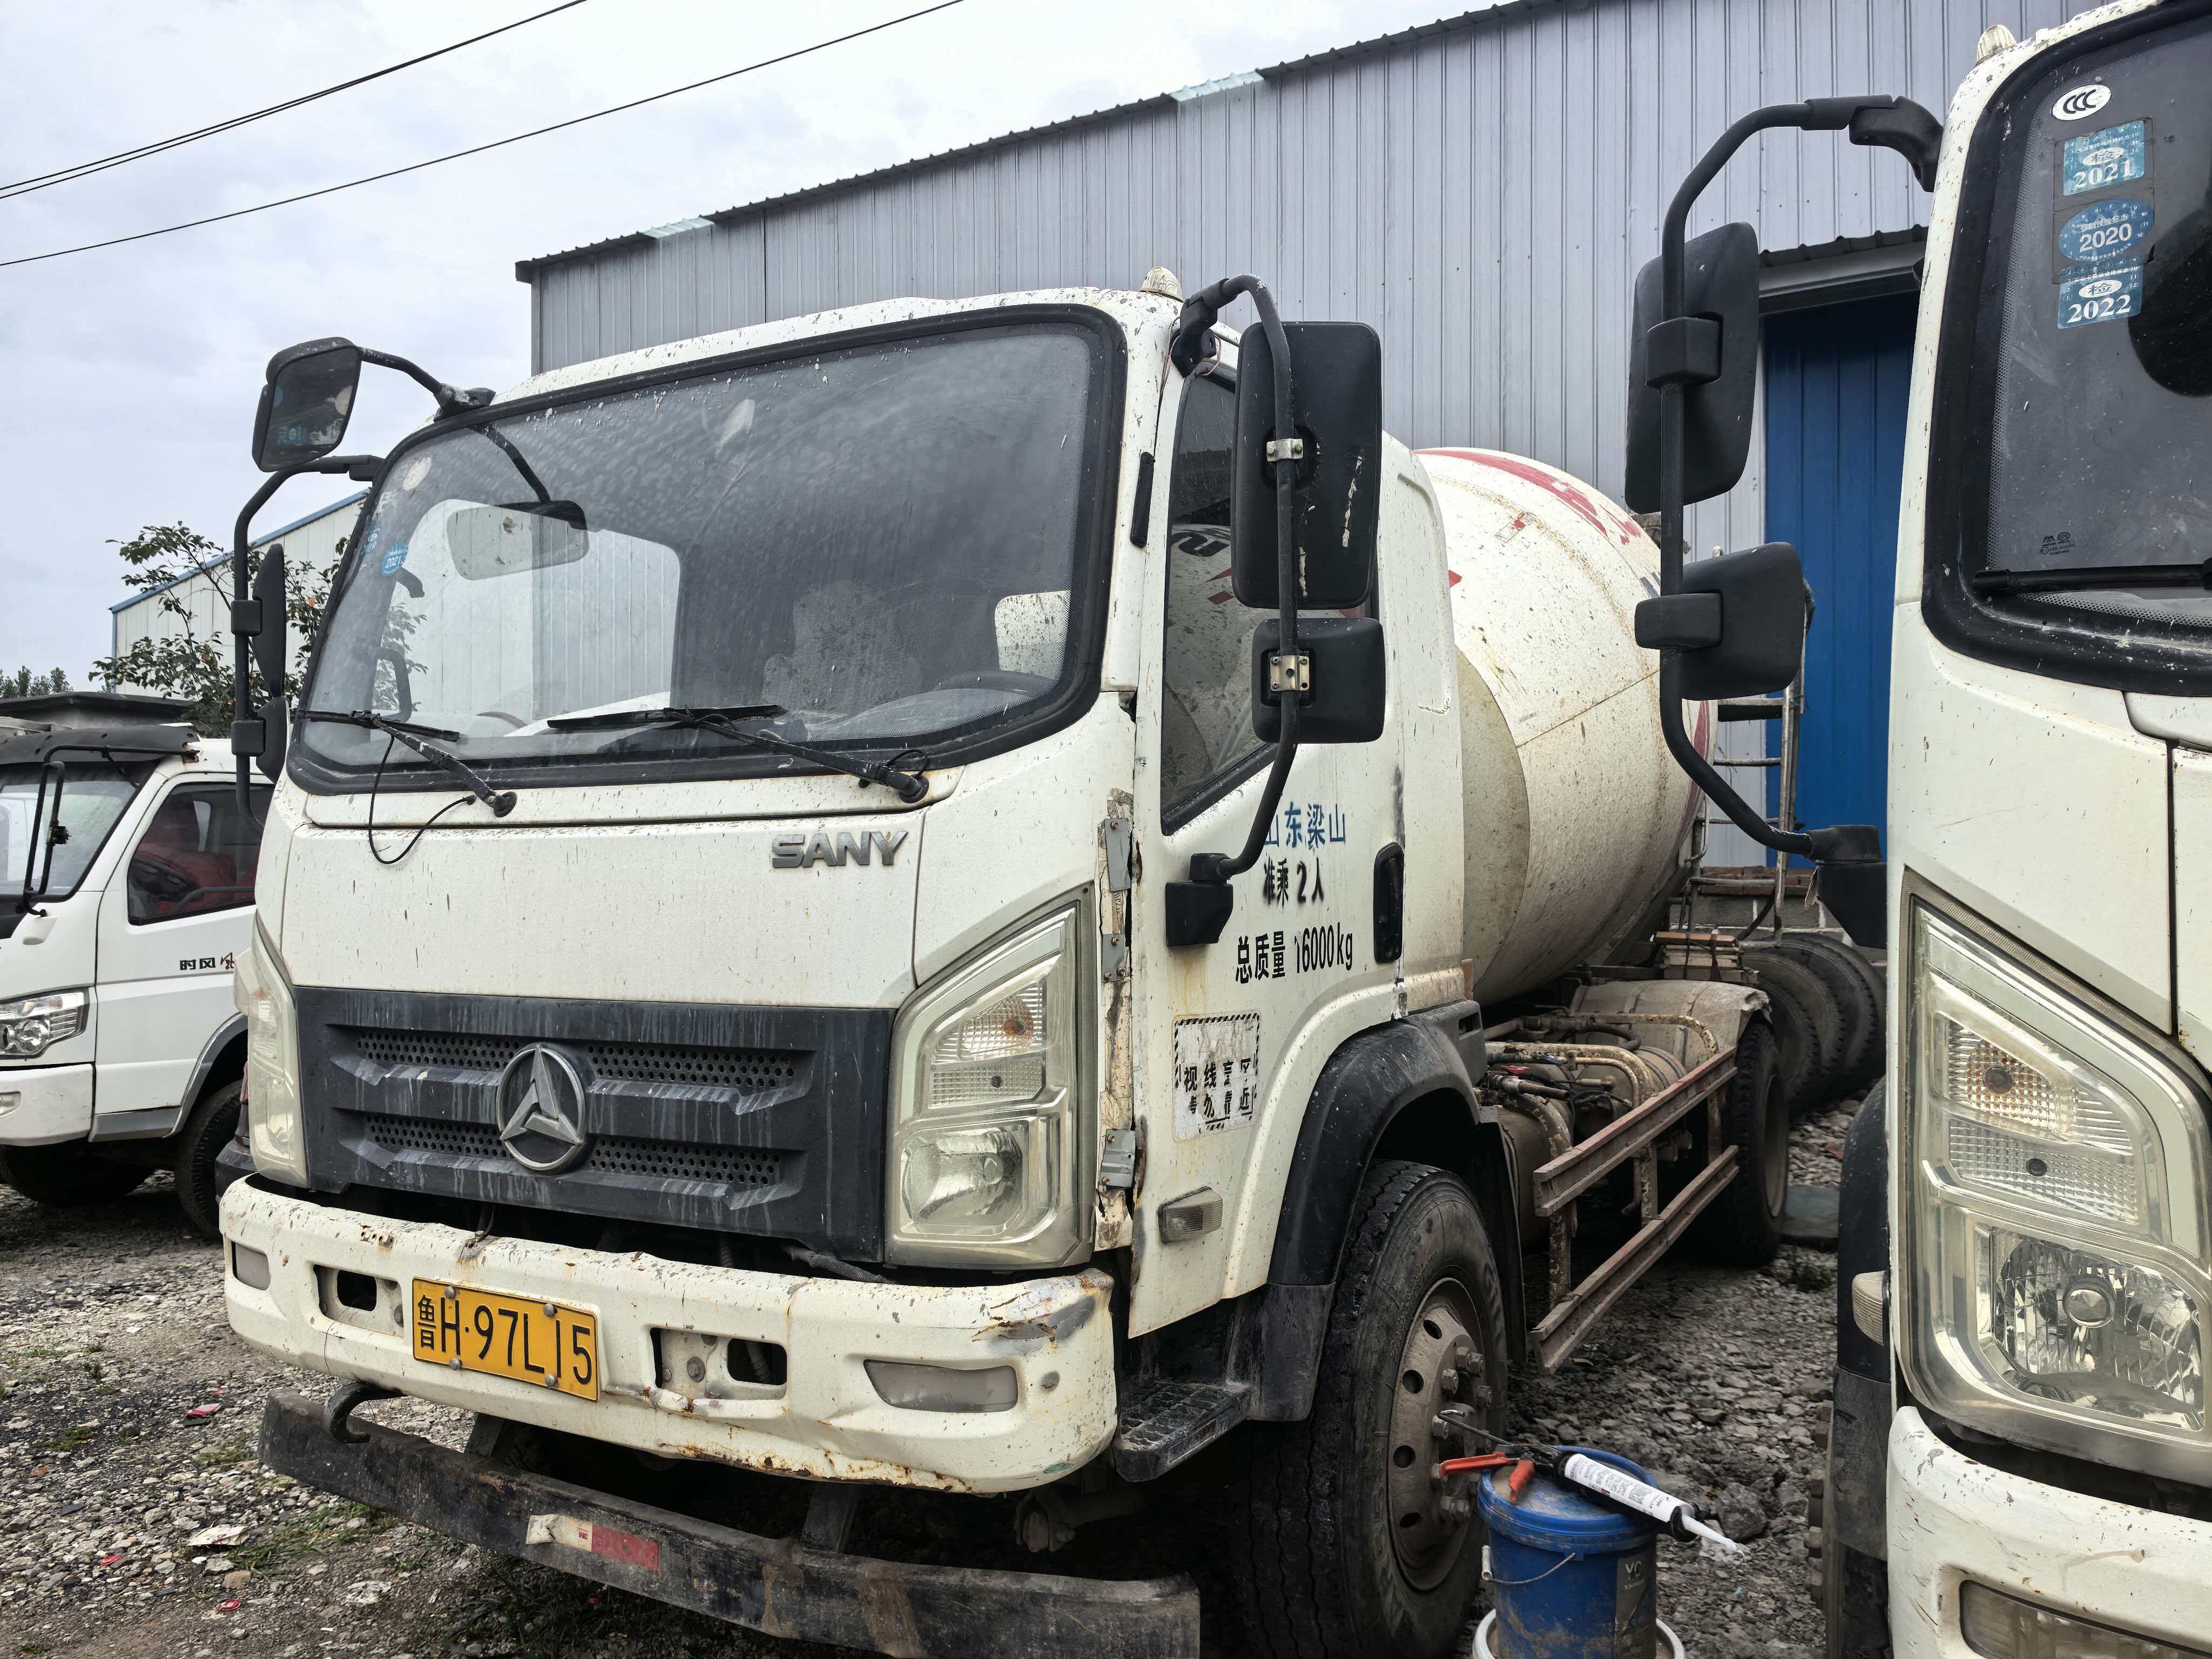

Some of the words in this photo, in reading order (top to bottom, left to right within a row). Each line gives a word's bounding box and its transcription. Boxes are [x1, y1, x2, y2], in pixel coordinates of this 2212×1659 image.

[2063, 89, 2096, 114] CCC
[2073, 159, 2135, 190] 2021
[2080, 223, 2132, 253] 2020
[2088, 282, 2113, 295] 检
[2067, 294, 2131, 323] 2022
[772, 831, 908, 868] SANY
